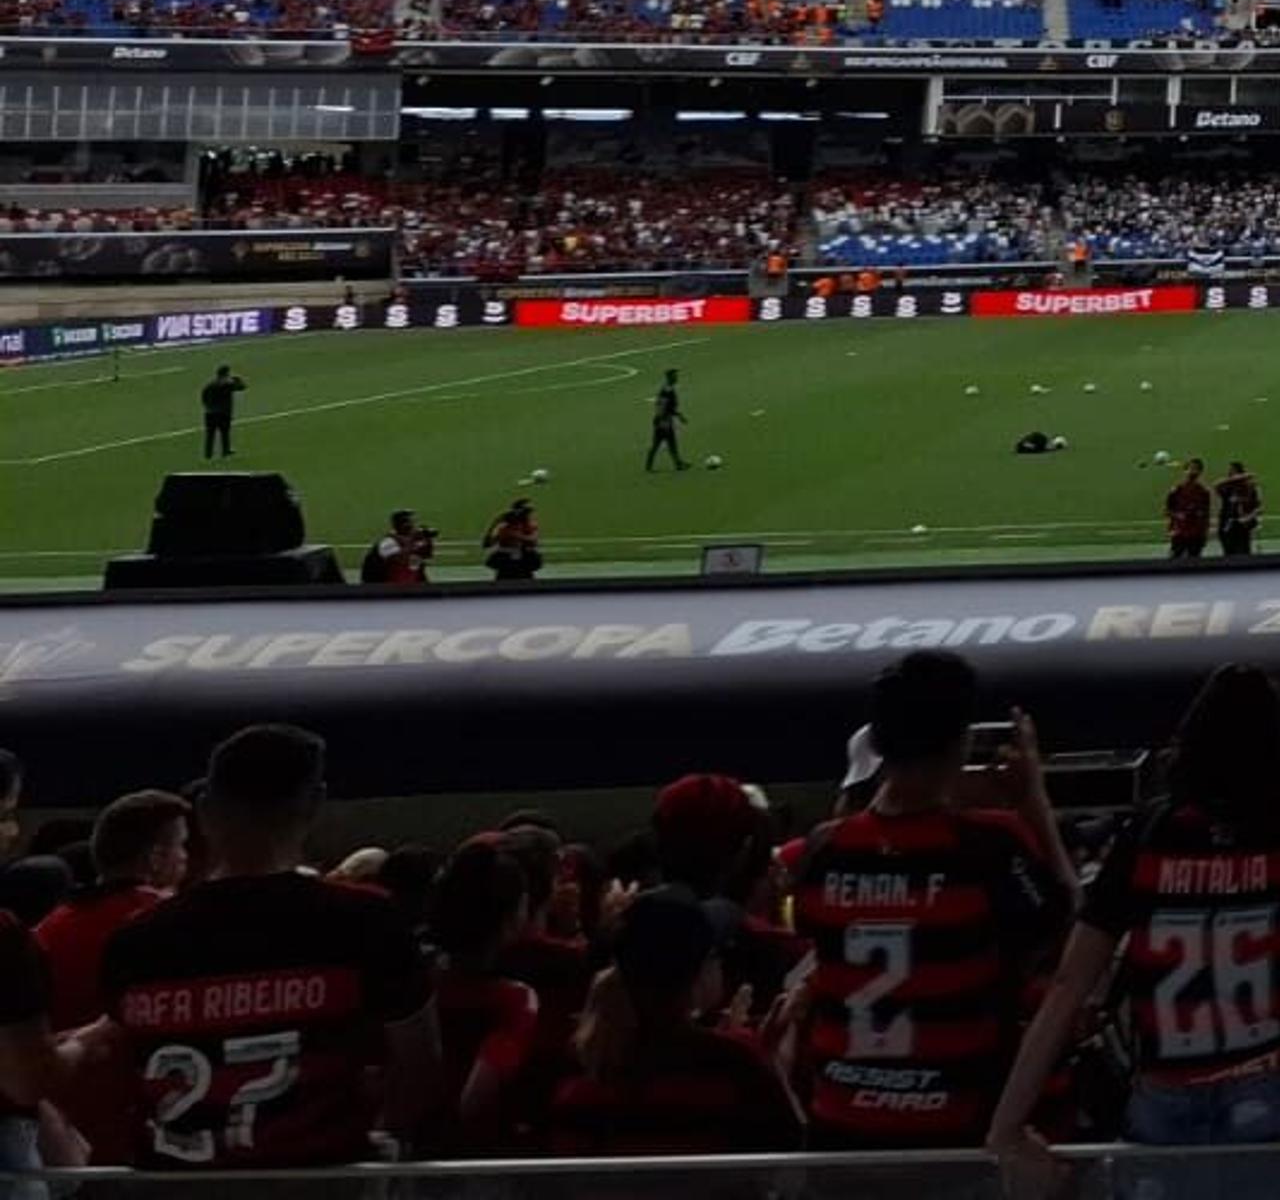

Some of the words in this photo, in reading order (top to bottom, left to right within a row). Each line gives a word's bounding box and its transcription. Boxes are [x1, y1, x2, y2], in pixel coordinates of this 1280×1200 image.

[725, 52, 761, 66] CBF
[1086, 54, 1119, 68] CBF
[1196, 111, 1261, 127] Betano
[559, 299, 706, 324] SUPERBET
[1015, 289, 1153, 313] SUPERBET
[122, 623, 697, 674] SUPERCOPA
[709, 610, 1077, 656] Betano
[1084, 600, 1237, 644] REI
[926, 871, 946, 910] F
[1157, 853, 1269, 895] NATALIA
[202, 975, 326, 1021] RIBEIRO
[844, 917, 917, 1060] 2
[144, 1029, 301, 1163] 27
